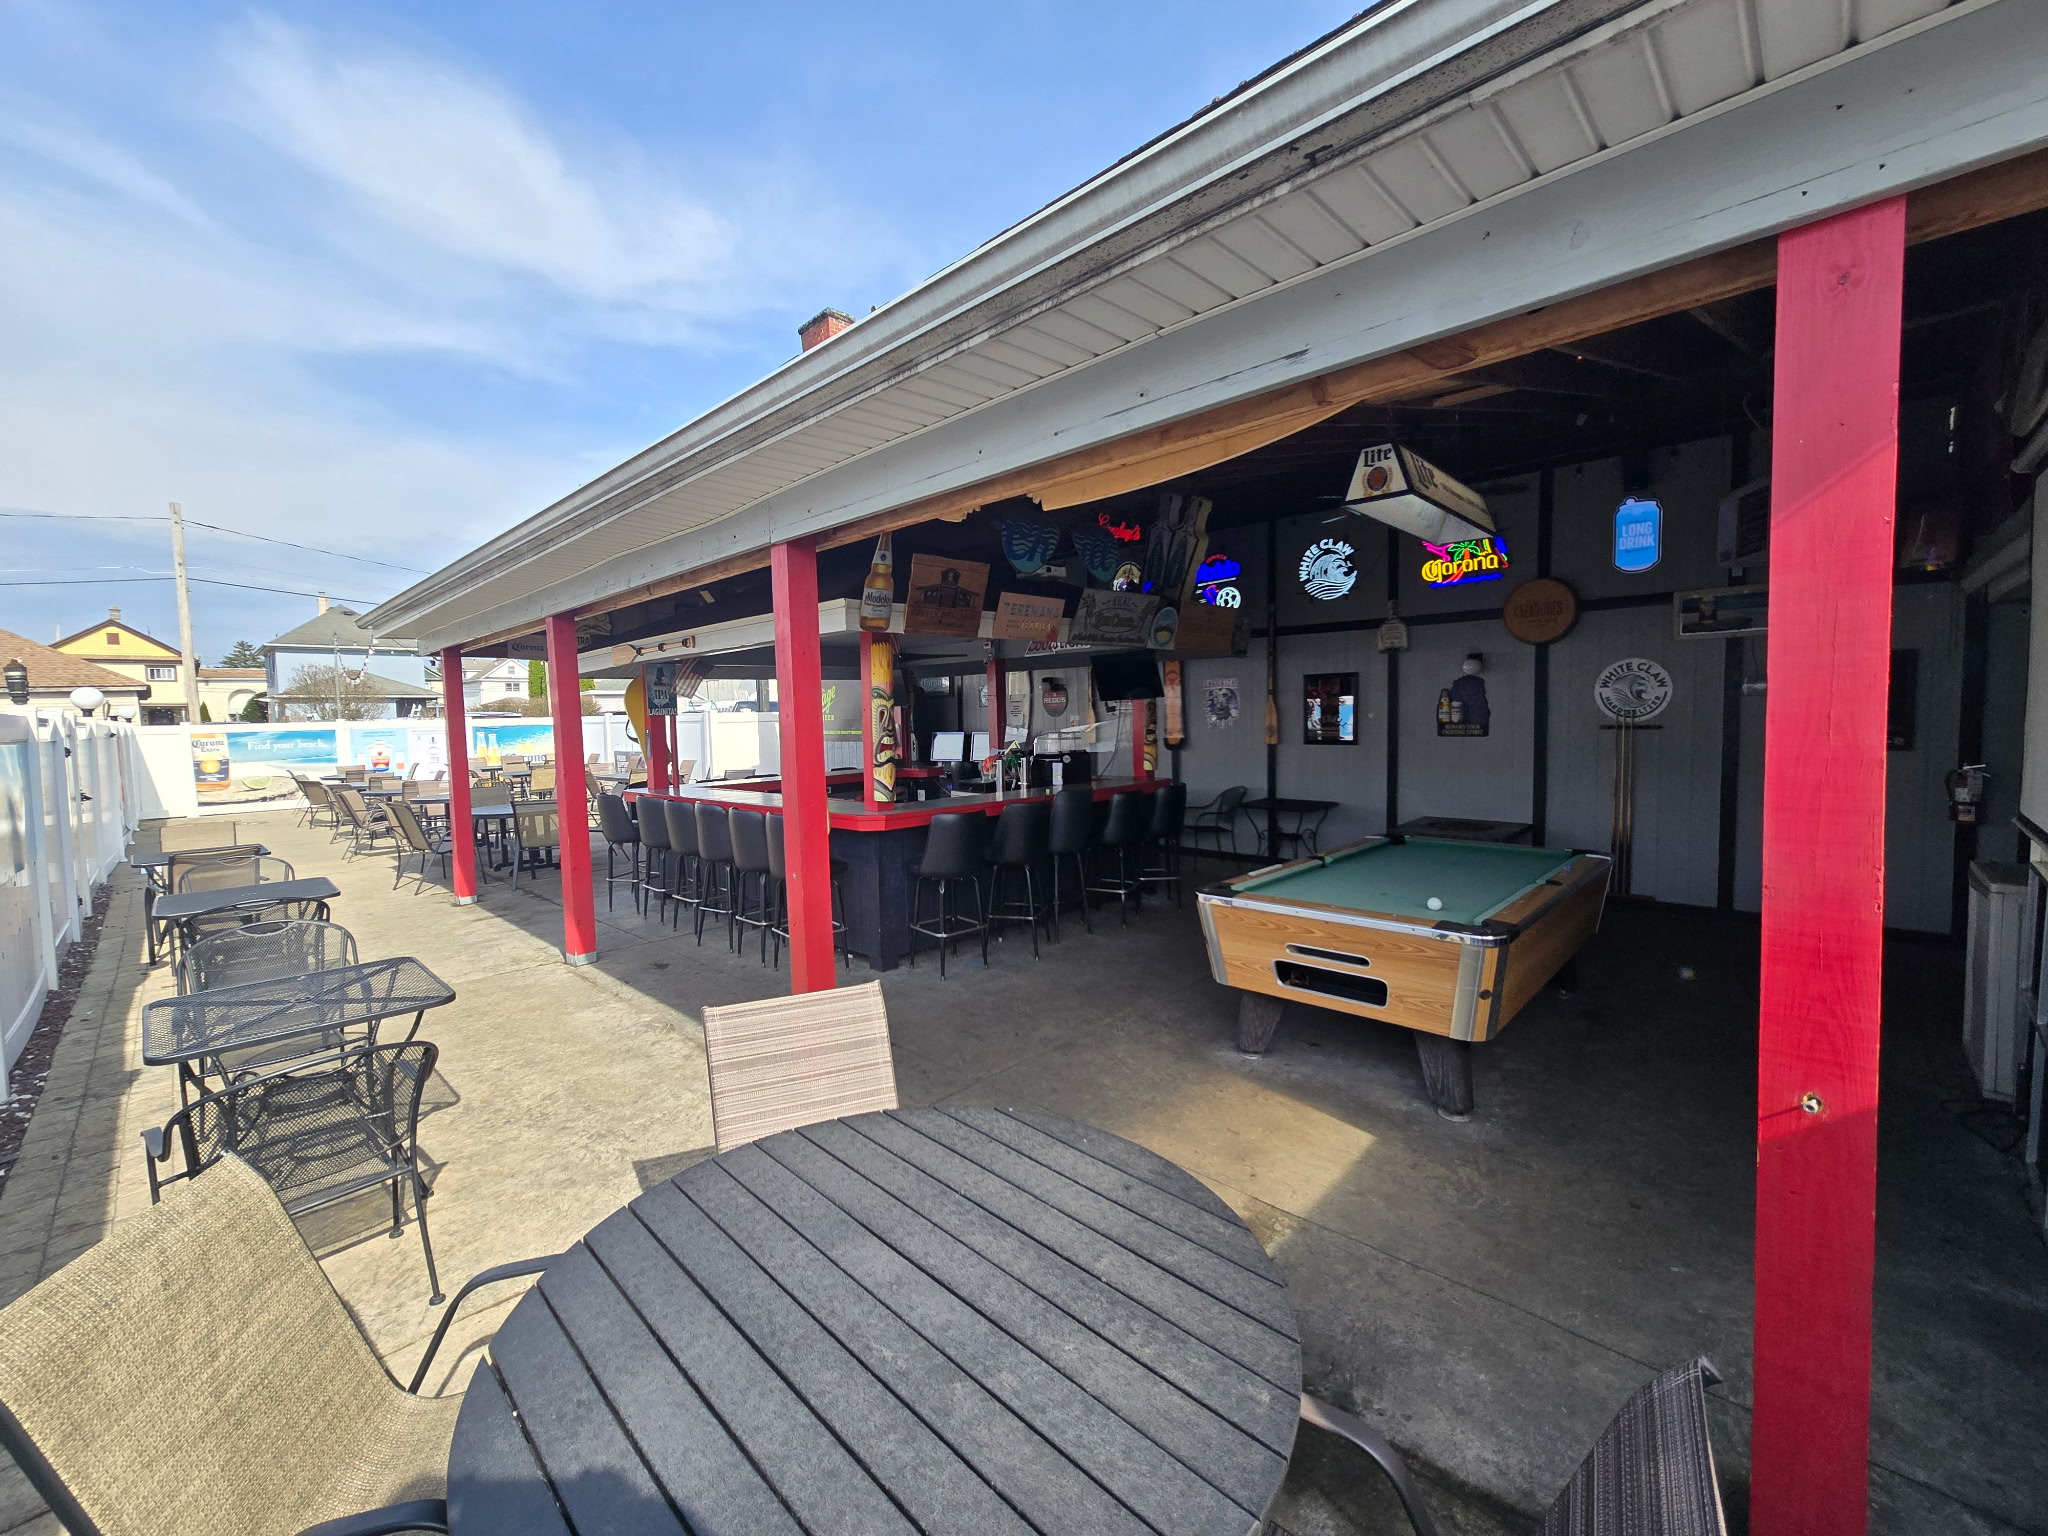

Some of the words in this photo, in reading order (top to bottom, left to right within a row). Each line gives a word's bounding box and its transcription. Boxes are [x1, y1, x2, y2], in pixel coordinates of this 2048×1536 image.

[1363, 448, 1392, 468] Lite
[1410, 452, 1438, 490] Lite
[1621, 521, 1653, 537] LONG
[1619, 534, 1655, 550] DRINK
[1299, 544, 1321, 582] WHITE
[1320, 538, 1355, 556] CLAW
[1421, 553, 1499, 583] Corona
[865, 591, 892, 605] Modelo
[1004, 602, 1059, 617] TEREMANA
[511, 642, 544, 652] Corona
[576, 635, 592, 647] TRA
[1600, 662, 1634, 689] WHITE
[1637, 662, 1667, 688] CLAW
[654, 689, 669, 700] IPA
[1605, 696, 1623, 713] HARD
[191, 739, 224, 749] Corona
[247, 741, 271, 751] Find
[273, 742, 294, 752] your
